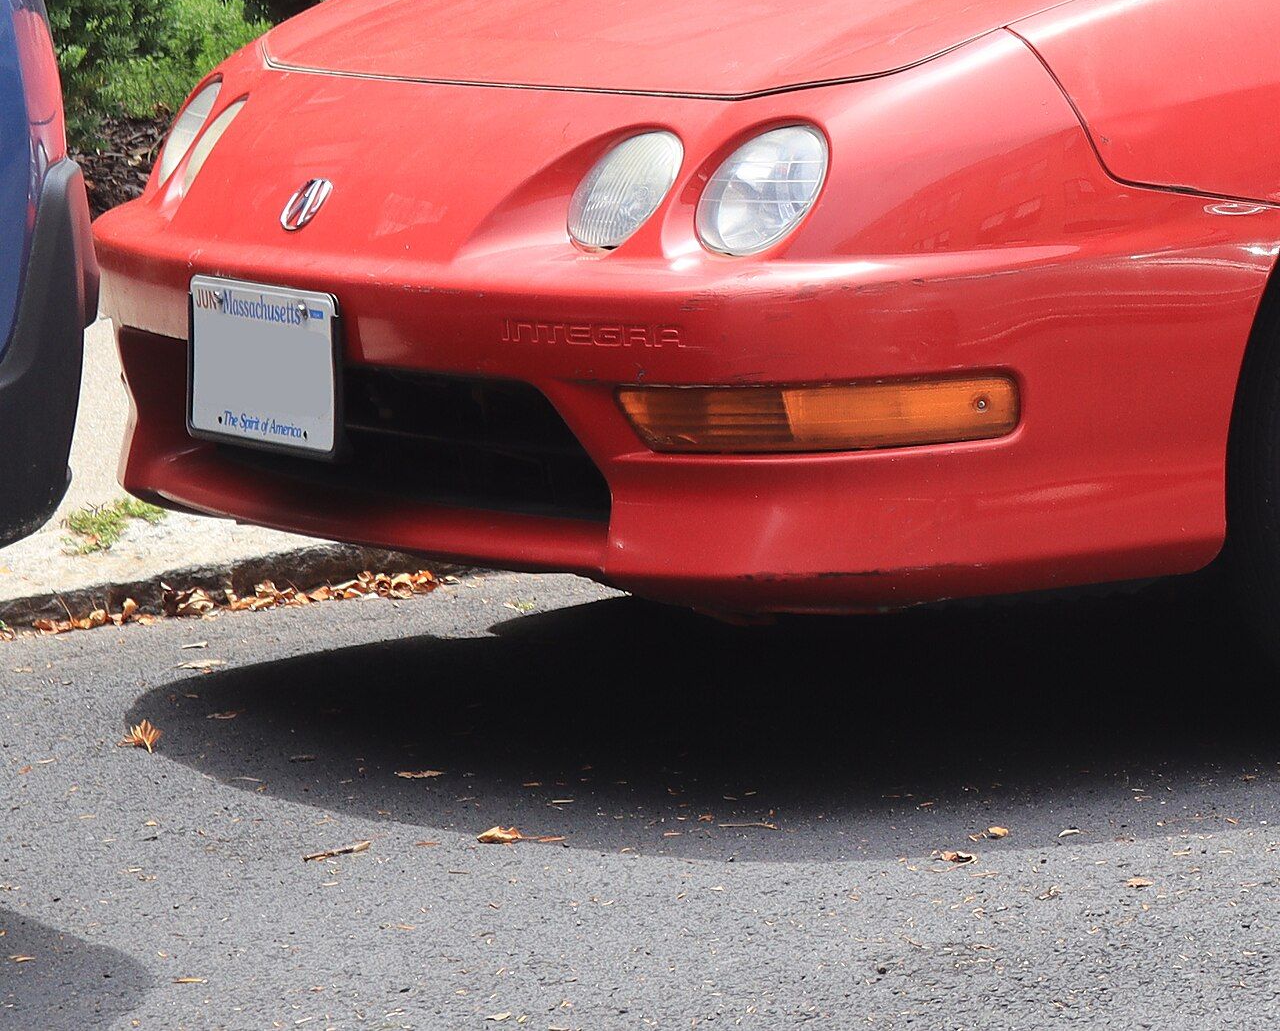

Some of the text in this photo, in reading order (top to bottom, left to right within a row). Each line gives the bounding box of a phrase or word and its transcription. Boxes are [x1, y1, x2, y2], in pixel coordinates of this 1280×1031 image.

[196, 288, 217, 311] JUN
[222, 290, 302, 326] Massachusetts
[502, 318, 687, 349] INTEGRA
[223, 410, 303, 439] The Spirit of America
